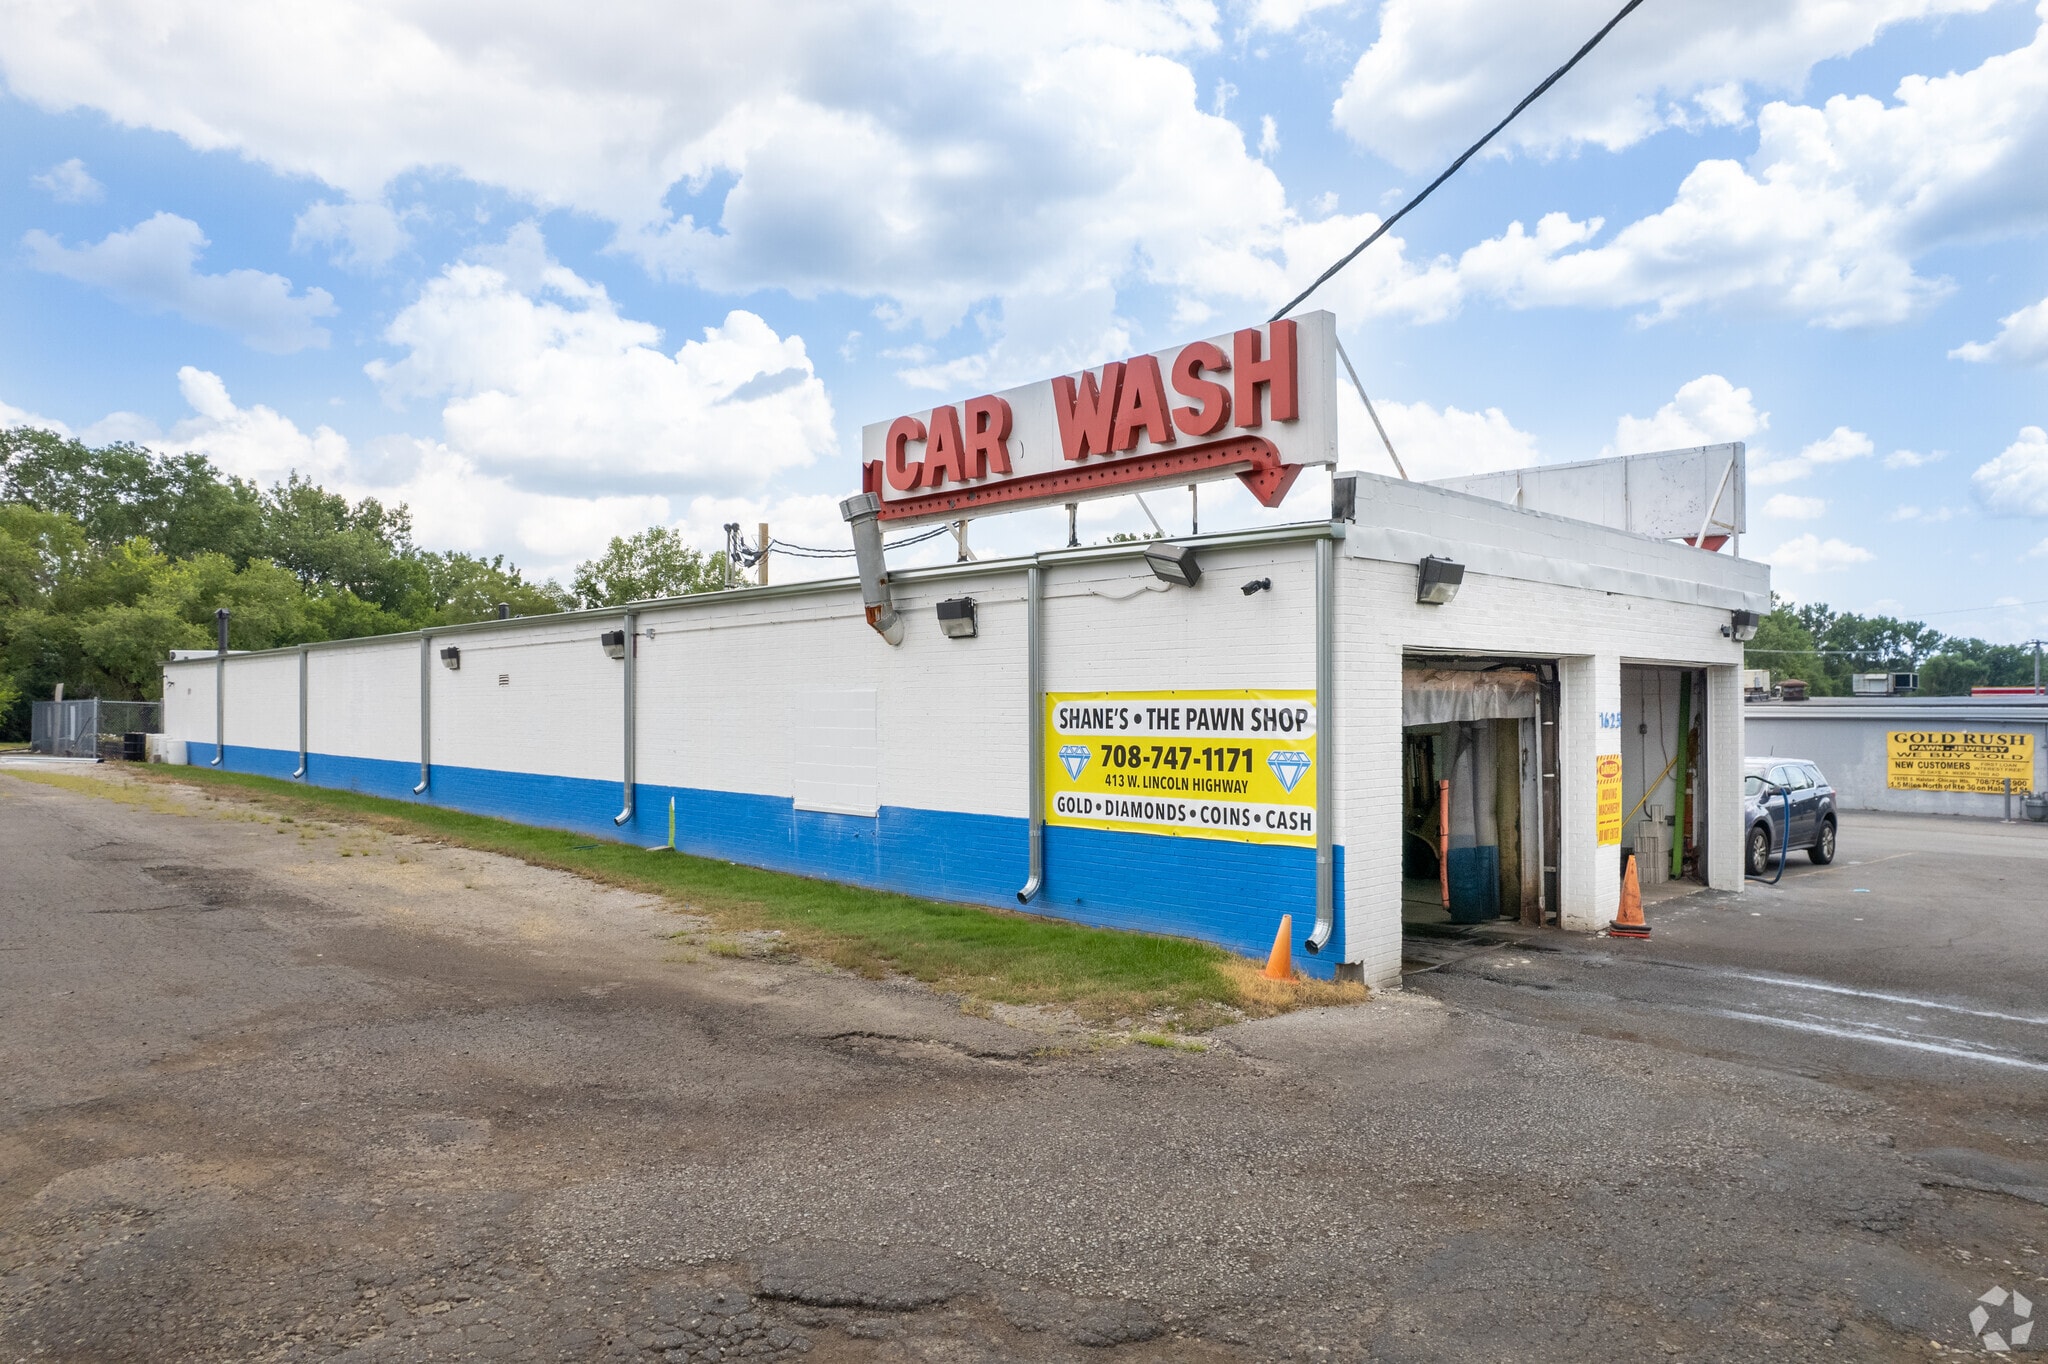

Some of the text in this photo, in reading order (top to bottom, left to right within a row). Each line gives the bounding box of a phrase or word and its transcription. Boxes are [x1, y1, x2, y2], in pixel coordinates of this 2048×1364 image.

[886, 318, 1299, 491] CAR WASH
[1059, 707, 1309, 732] SHANE'S THE PAWN SHOP
[1894, 733, 2026, 745] GOLD RUSH
[1100, 744, 1253, 773] 708-747-1171
[1895, 761, 1971, 770] NEW CUSTOMERS
[1105, 773, 1249, 794] 413 W. LINCOLN HIGHWAY
[1057, 796, 1312, 832] GOLD DIAMONDS COINS CASH
